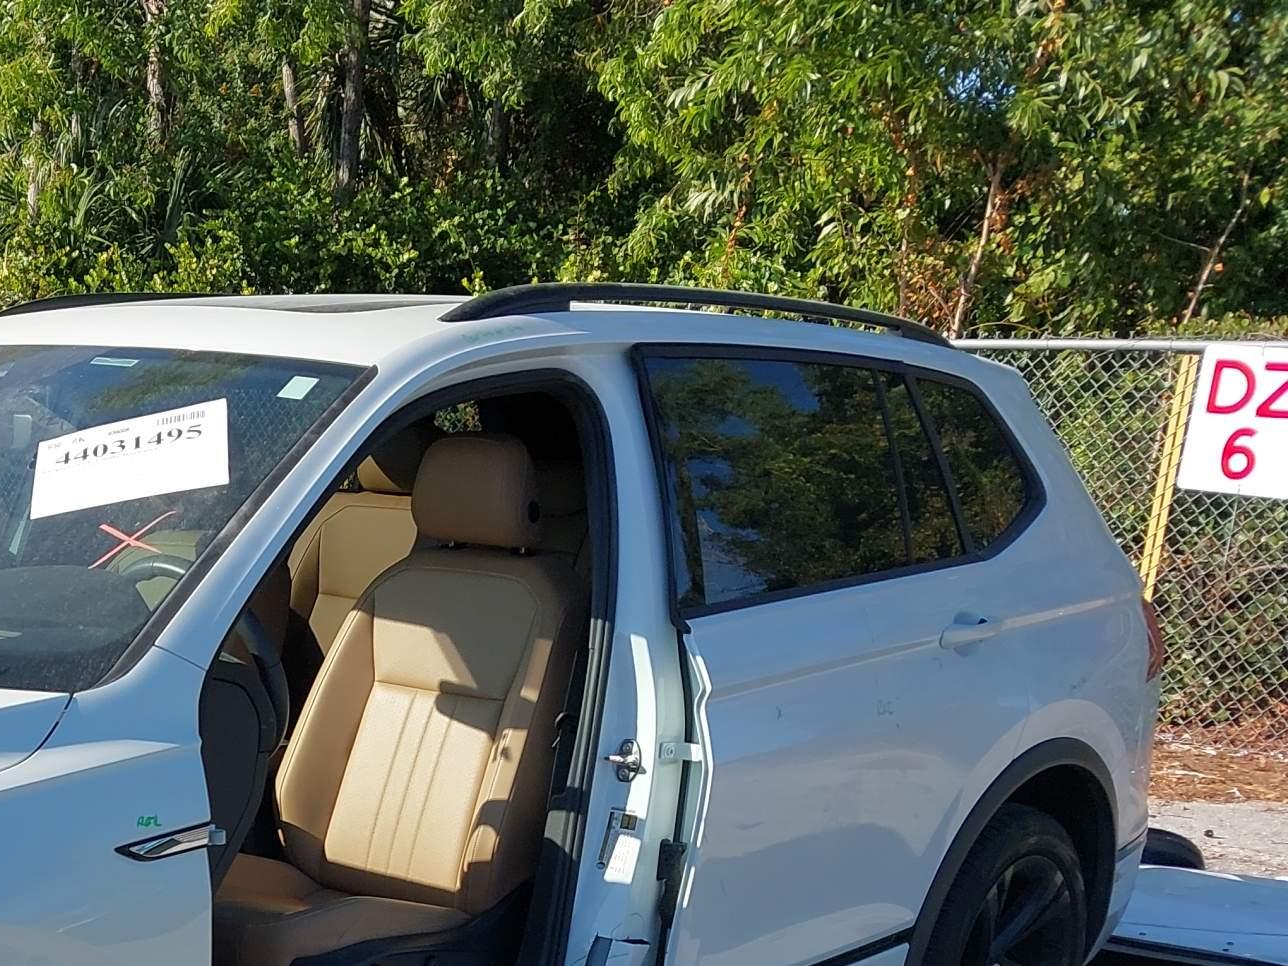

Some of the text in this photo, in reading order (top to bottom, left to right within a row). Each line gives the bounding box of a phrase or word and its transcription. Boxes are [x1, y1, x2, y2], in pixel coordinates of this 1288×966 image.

[1205, 358, 1288, 419] DZ
[55, 423, 203, 465] 44031495
[1220, 427, 1258, 481] 6
